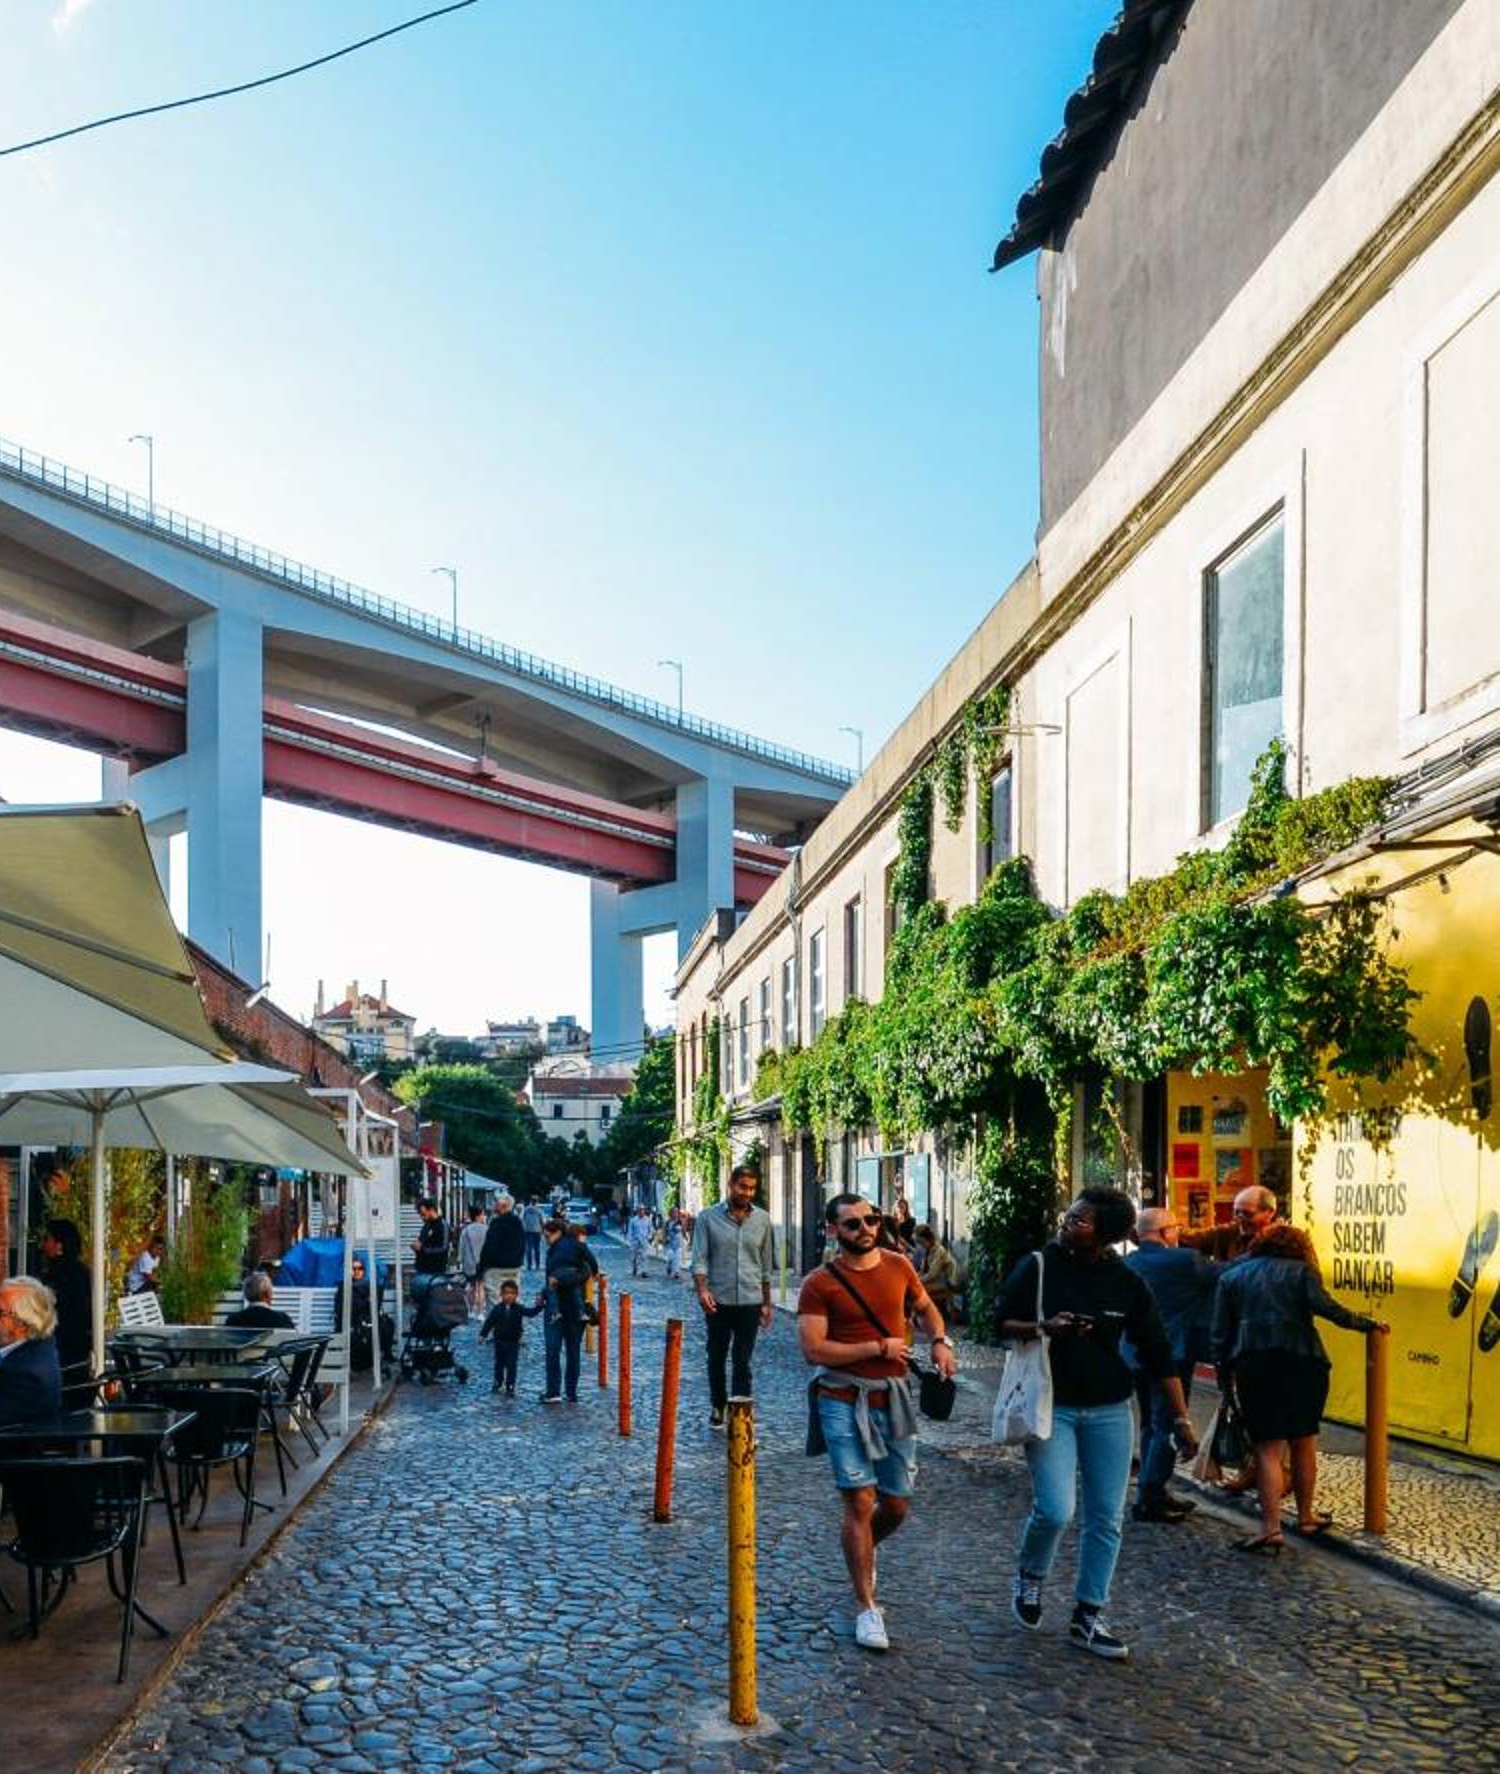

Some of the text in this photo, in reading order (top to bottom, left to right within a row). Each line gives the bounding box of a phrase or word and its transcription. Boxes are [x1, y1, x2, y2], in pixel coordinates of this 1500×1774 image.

[1335, 1148, 1355, 1180] OS
[1333, 1183, 1407, 1217] BRANCOS
[1333, 1220, 1386, 1255] SABEM
[1333, 1257, 1395, 1299] DANÇAR
